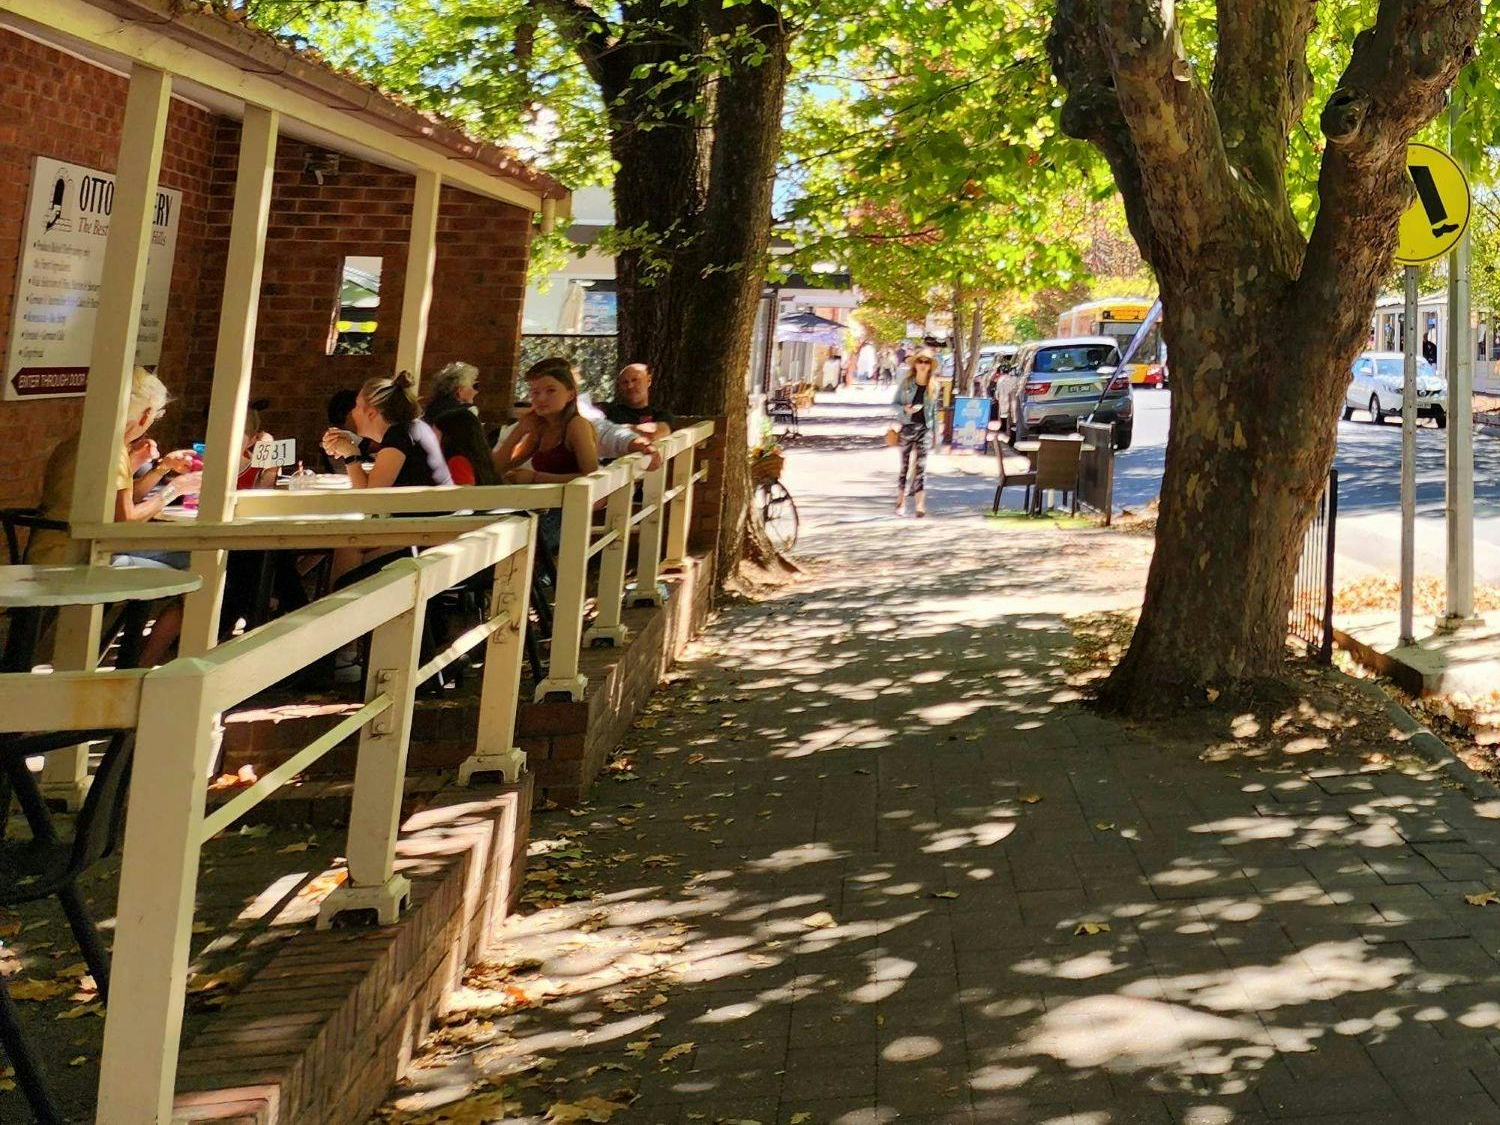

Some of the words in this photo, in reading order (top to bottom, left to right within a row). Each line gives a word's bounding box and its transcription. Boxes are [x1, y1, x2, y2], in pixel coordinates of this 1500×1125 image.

[78, 217, 92, 233] The
[93, 220, 109, 236] Best
[18, 374, 40, 388] ENTER
